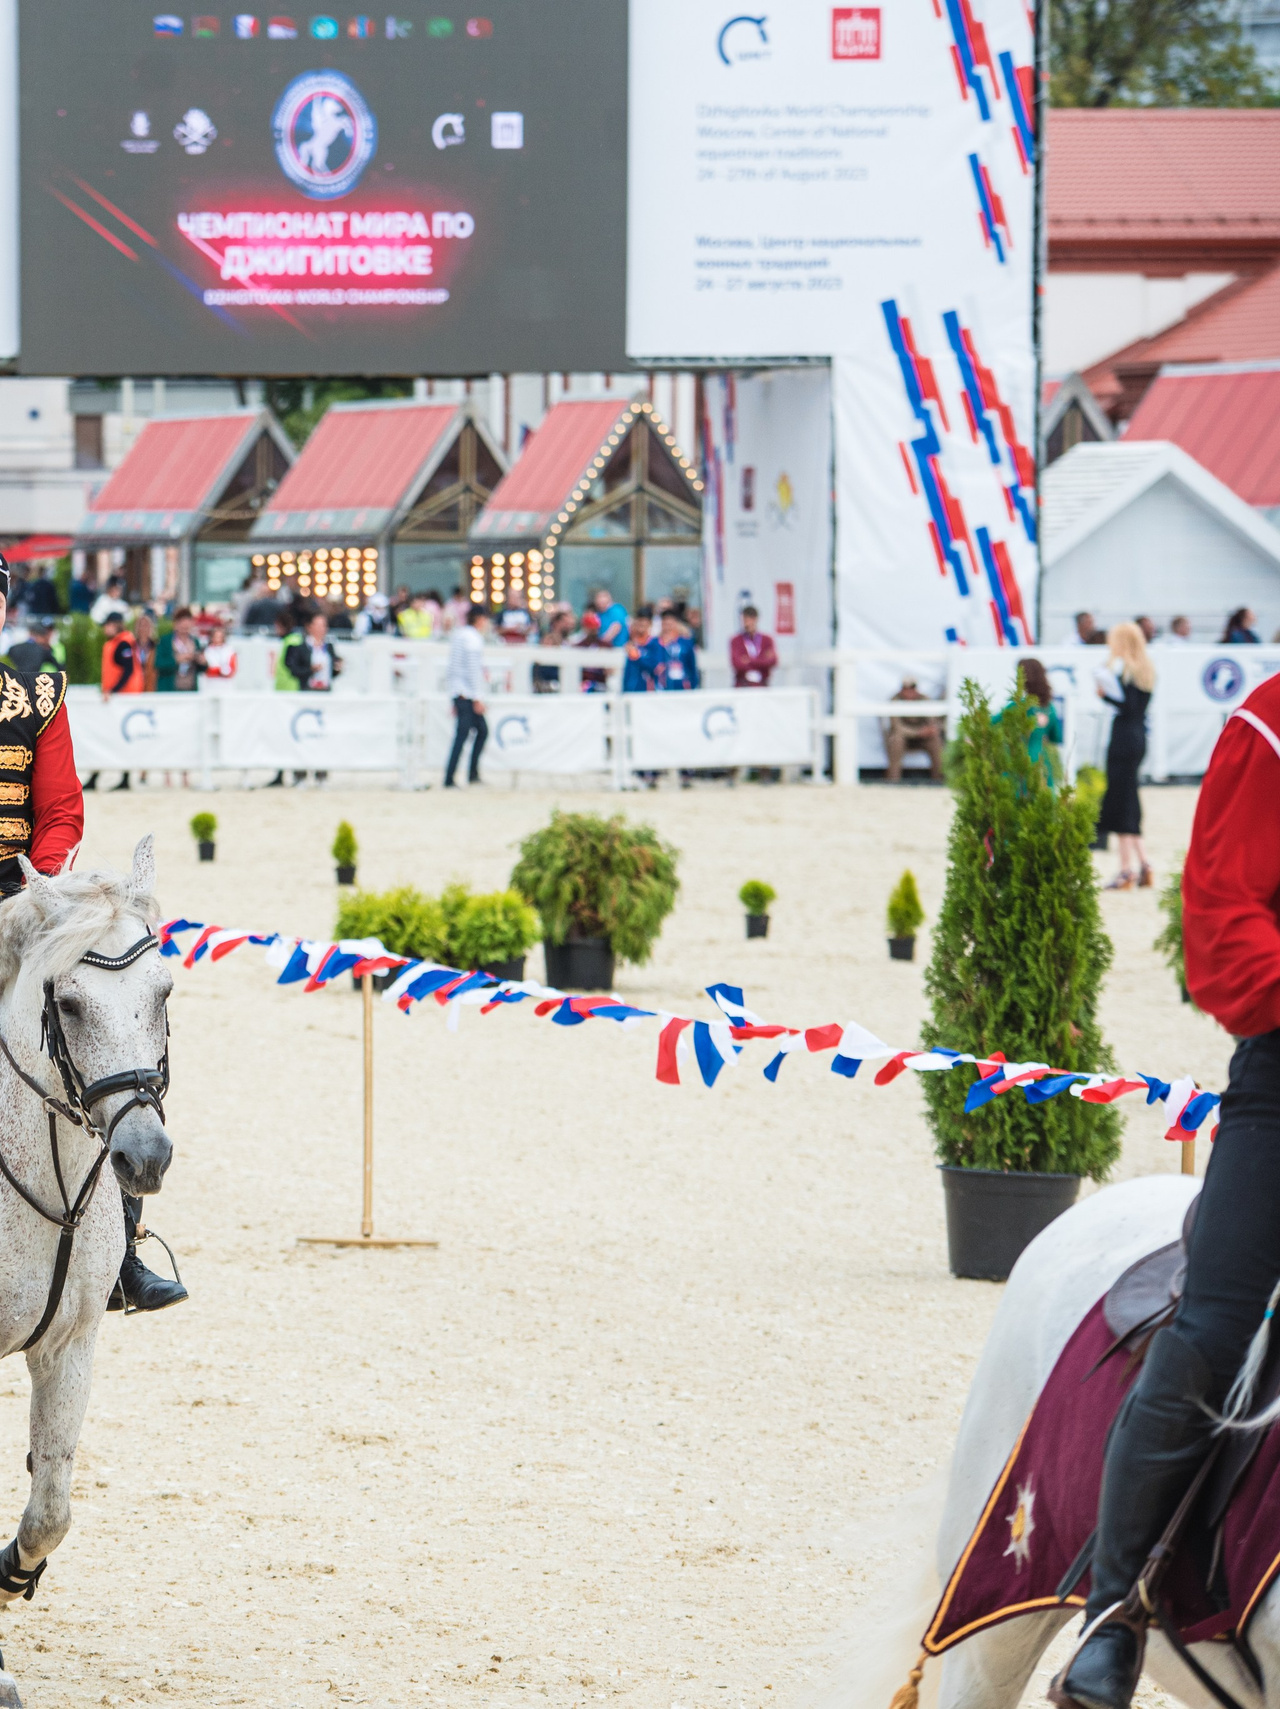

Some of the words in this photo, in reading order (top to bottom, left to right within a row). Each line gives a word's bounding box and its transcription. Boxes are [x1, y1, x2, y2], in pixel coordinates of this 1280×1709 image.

[177, 211, 348, 239] ЧЕМПИОНАТ
[349, 211, 430, 239] МИРА
[432, 211, 475, 239] ПО
[220, 244, 433, 280] ДЖИГИТОВКЕ
